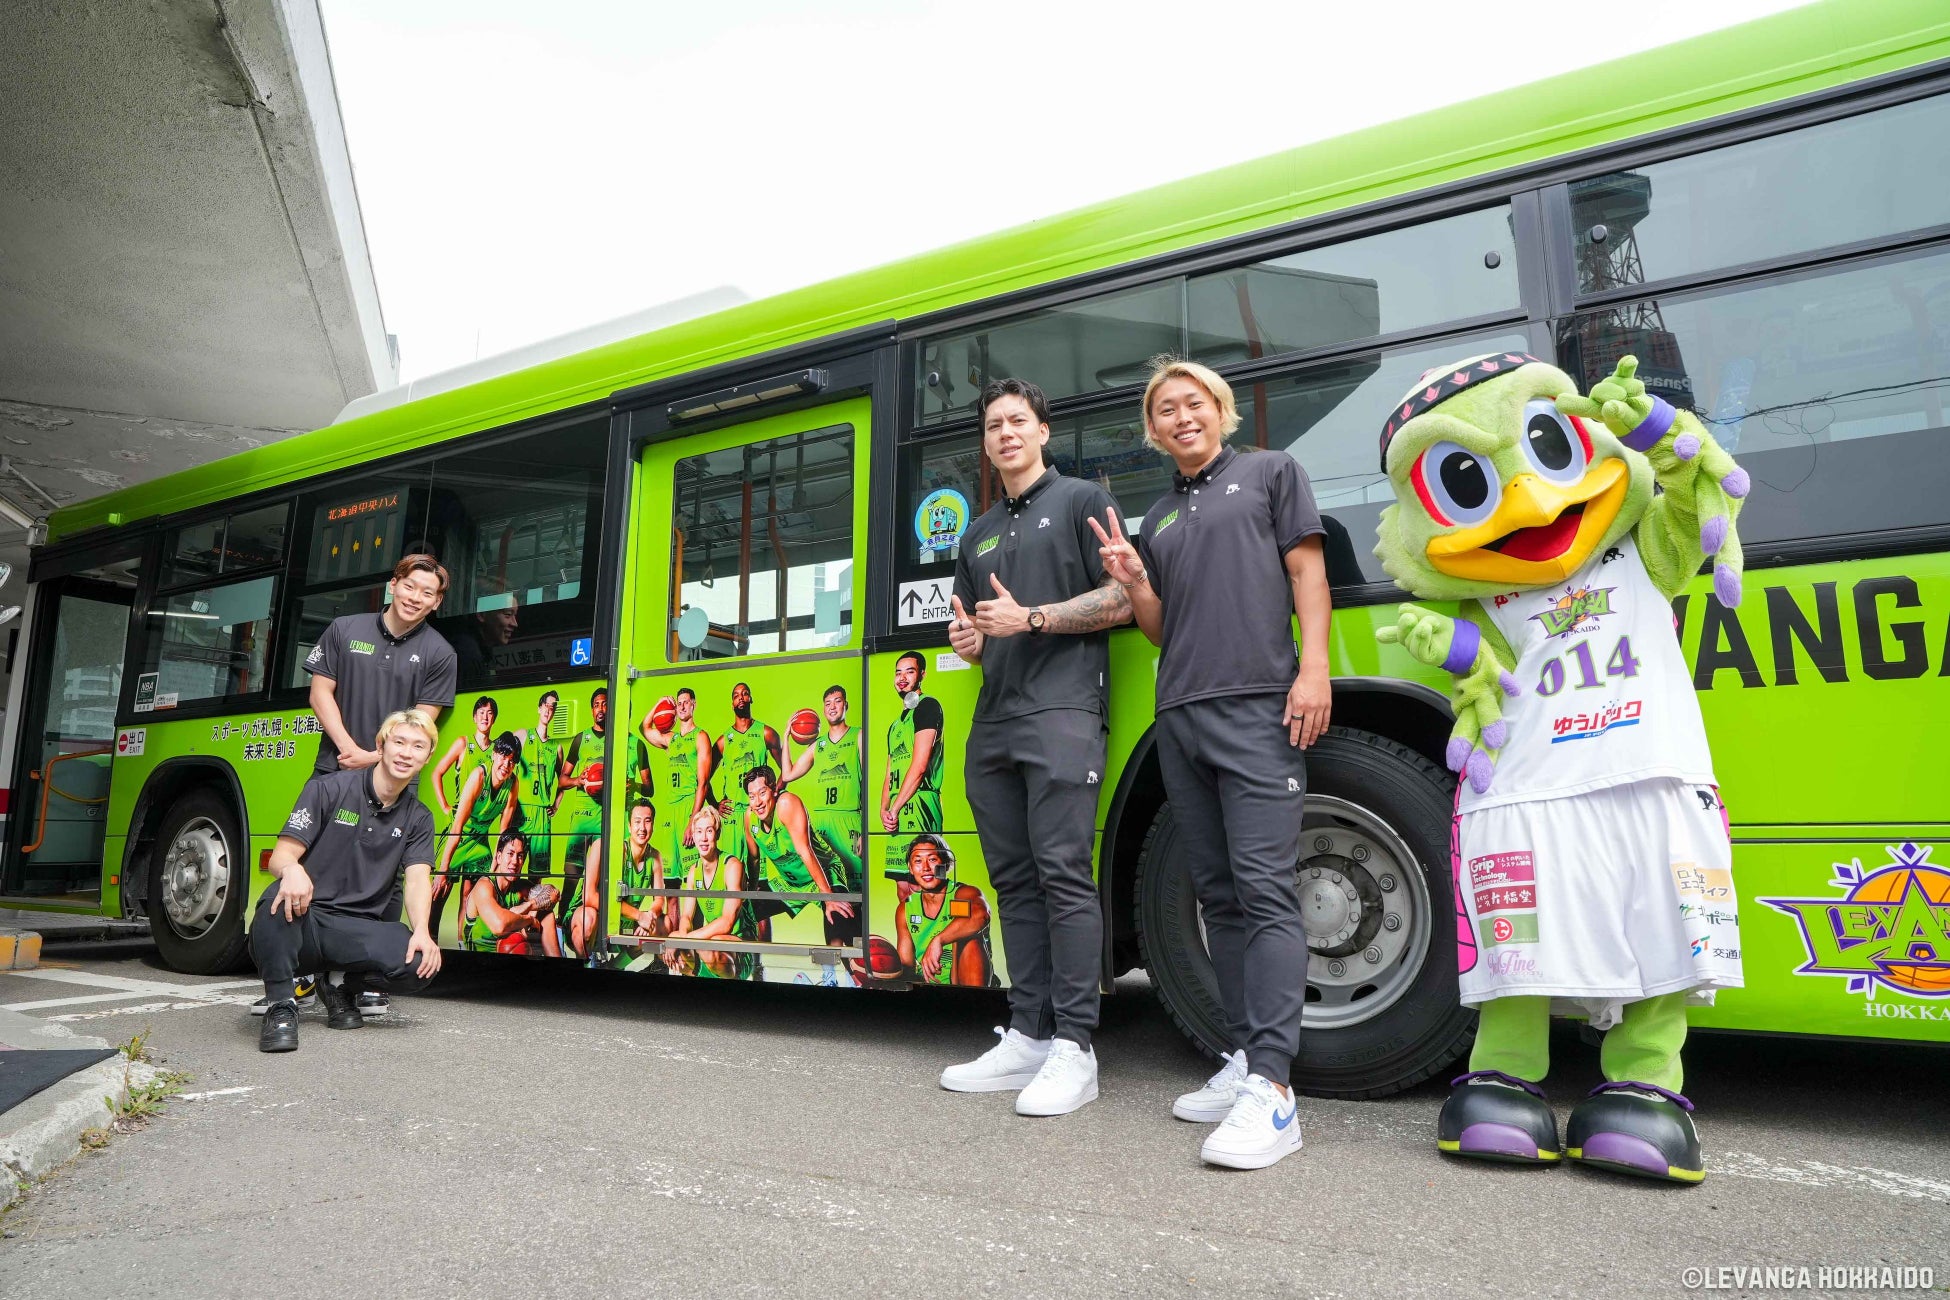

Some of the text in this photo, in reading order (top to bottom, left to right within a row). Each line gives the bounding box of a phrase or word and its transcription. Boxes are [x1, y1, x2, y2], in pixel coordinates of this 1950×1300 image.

[922, 605, 957, 620] ENTRA
[129, 731, 145, 745] 出口
[129, 745, 141, 754] EXIT
[243, 741, 296, 761] 未来を創る
[888, 769, 900, 791] 34
[826, 787, 838, 805] 18
[903, 802, 914, 816] 34
[1470, 857, 1495, 874] Grip
[1472, 872, 1507, 884] Technology
